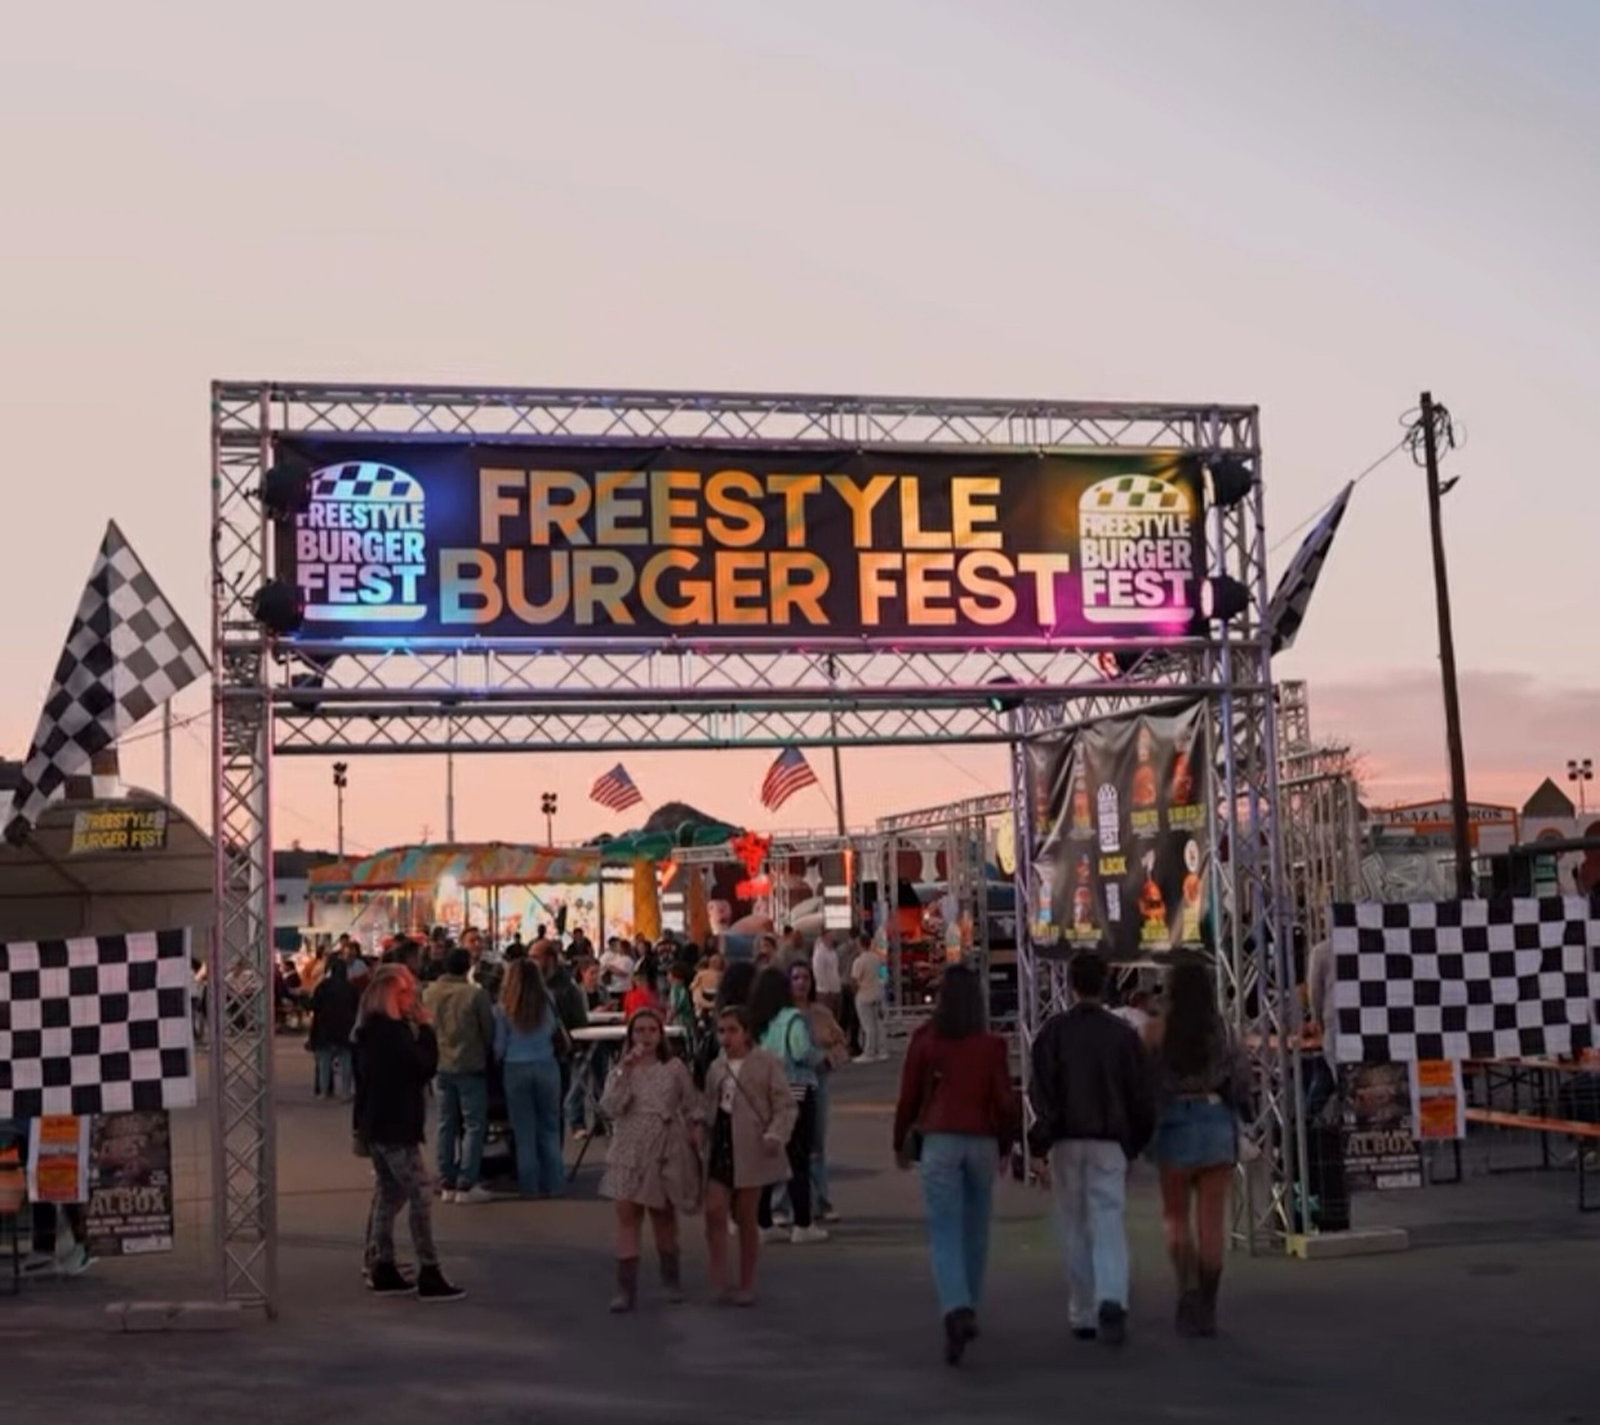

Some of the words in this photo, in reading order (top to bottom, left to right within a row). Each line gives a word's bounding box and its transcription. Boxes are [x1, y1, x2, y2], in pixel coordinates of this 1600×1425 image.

[479, 468, 1003, 549] FREESTYLE
[1079, 513, 1191, 538] FREESTYLE
[296, 529, 425, 563] BURGER
[1080, 538, 1192, 570] BURGER
[296, 564, 426, 604] FEST
[438, 548, 829, 626] BURGER
[859, 551, 1070, 627] FEST
[1082, 570, 1194, 607] FEST
[1390, 811, 1440, 824] PLAZA
[131, 829, 164, 848] FEST
[1347, 1135, 1417, 1156] ALBOX
[89, 1194, 167, 1215] ALBOX
